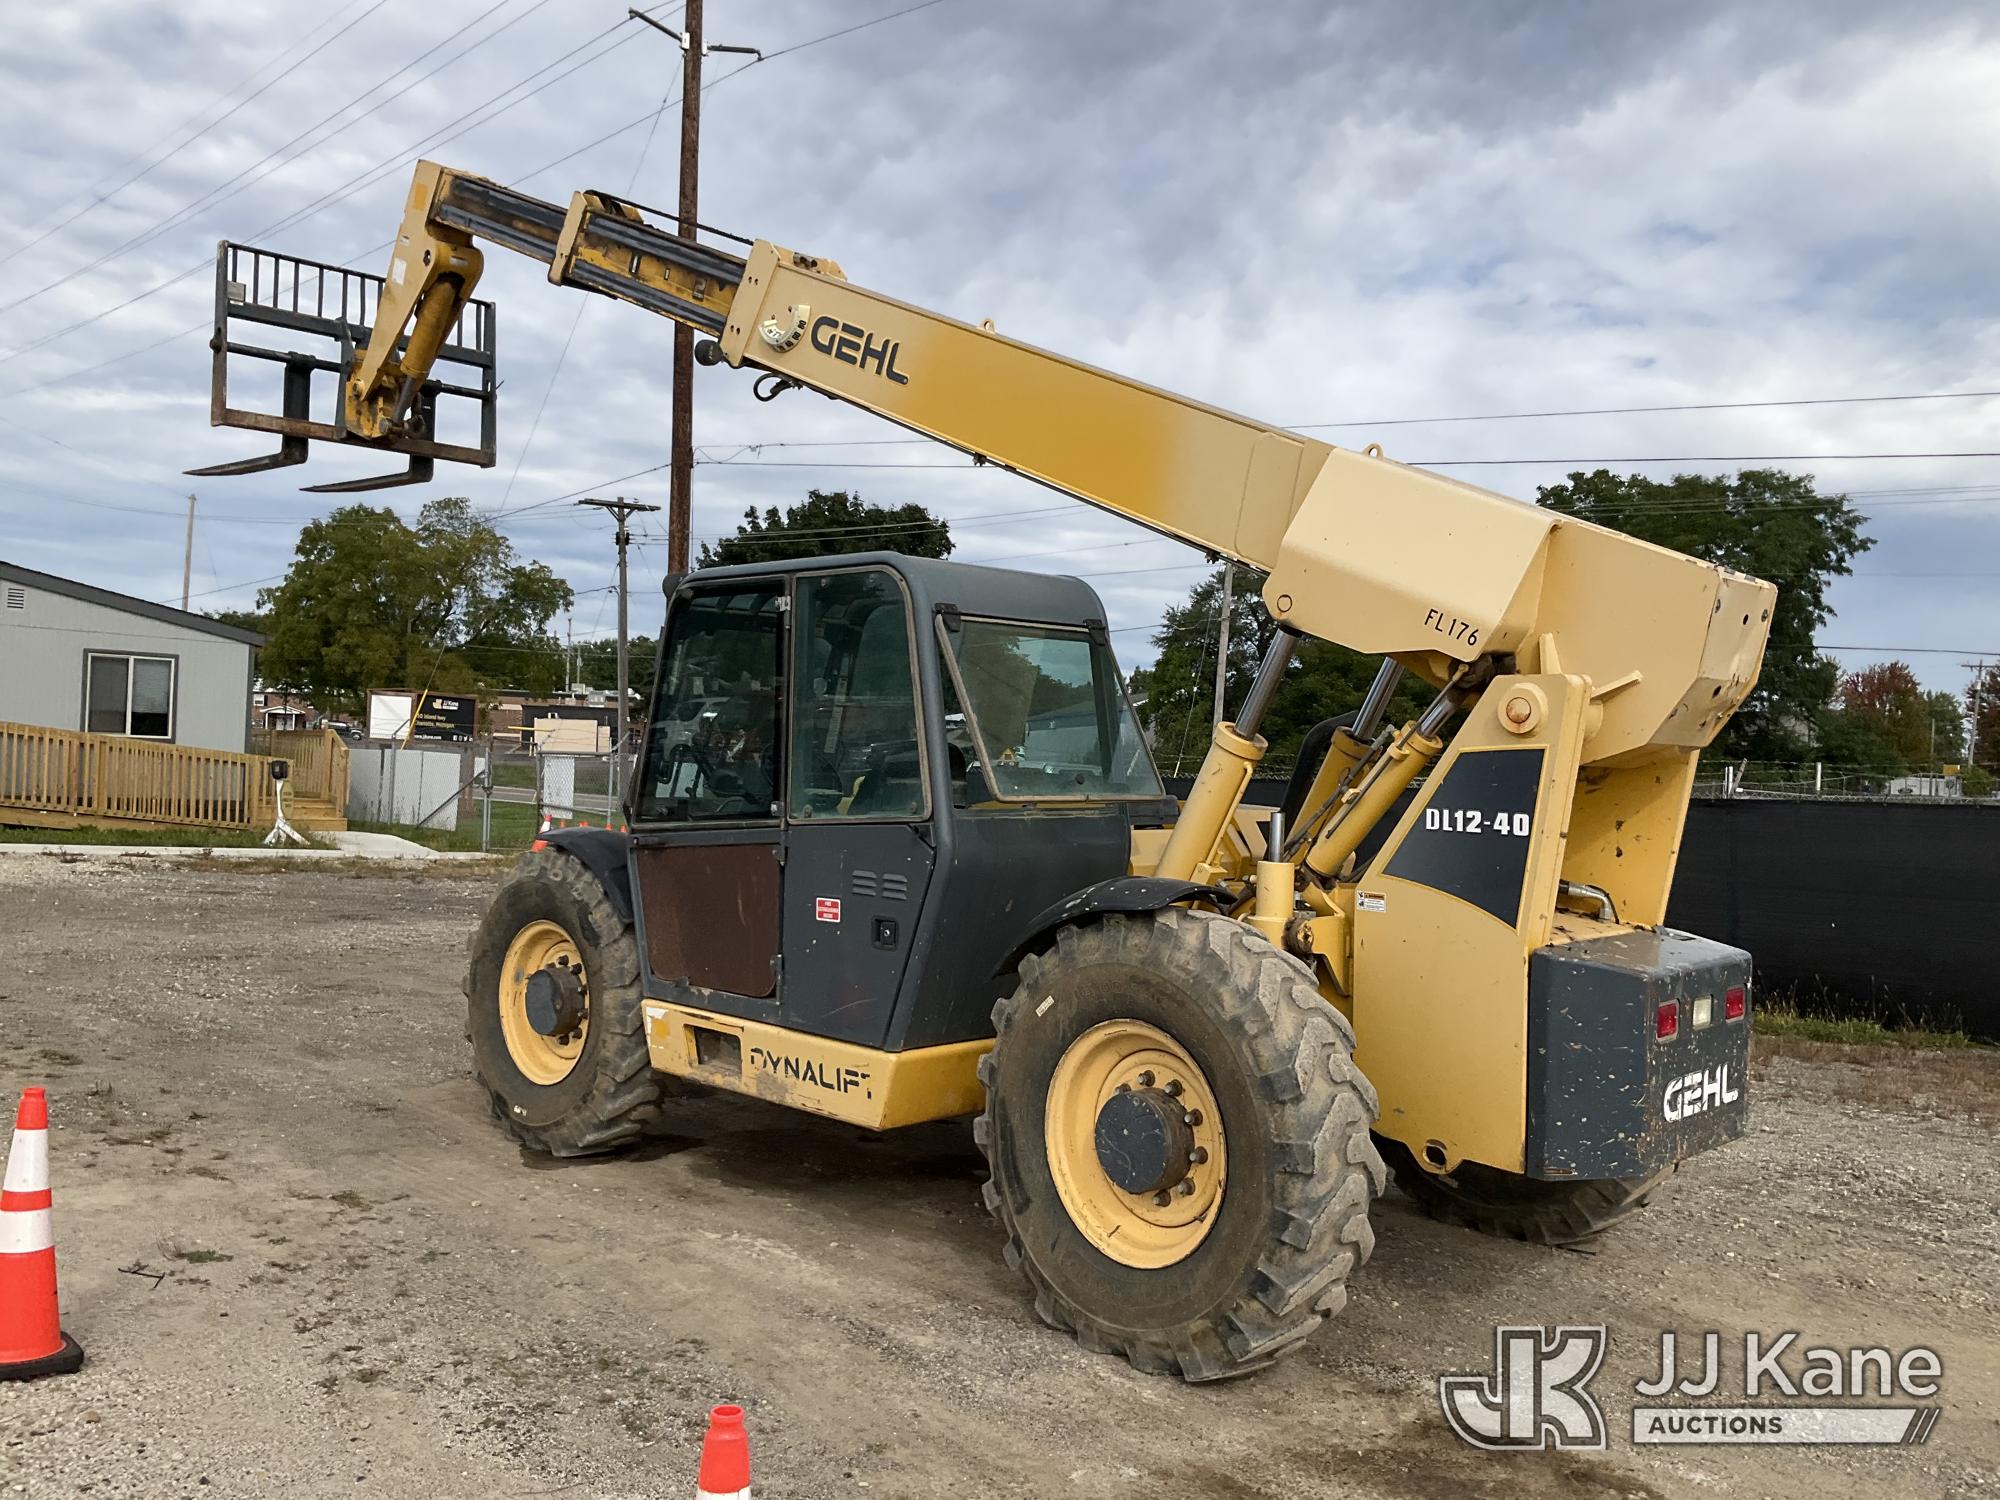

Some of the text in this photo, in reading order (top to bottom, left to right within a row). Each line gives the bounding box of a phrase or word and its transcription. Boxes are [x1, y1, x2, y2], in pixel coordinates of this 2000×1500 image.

[811, 315, 909, 385] GEHL
[1424, 608, 1479, 646] FL176
[1425, 808, 1530, 837] DL12-40
[1663, 1063, 1739, 1123] GEHL
